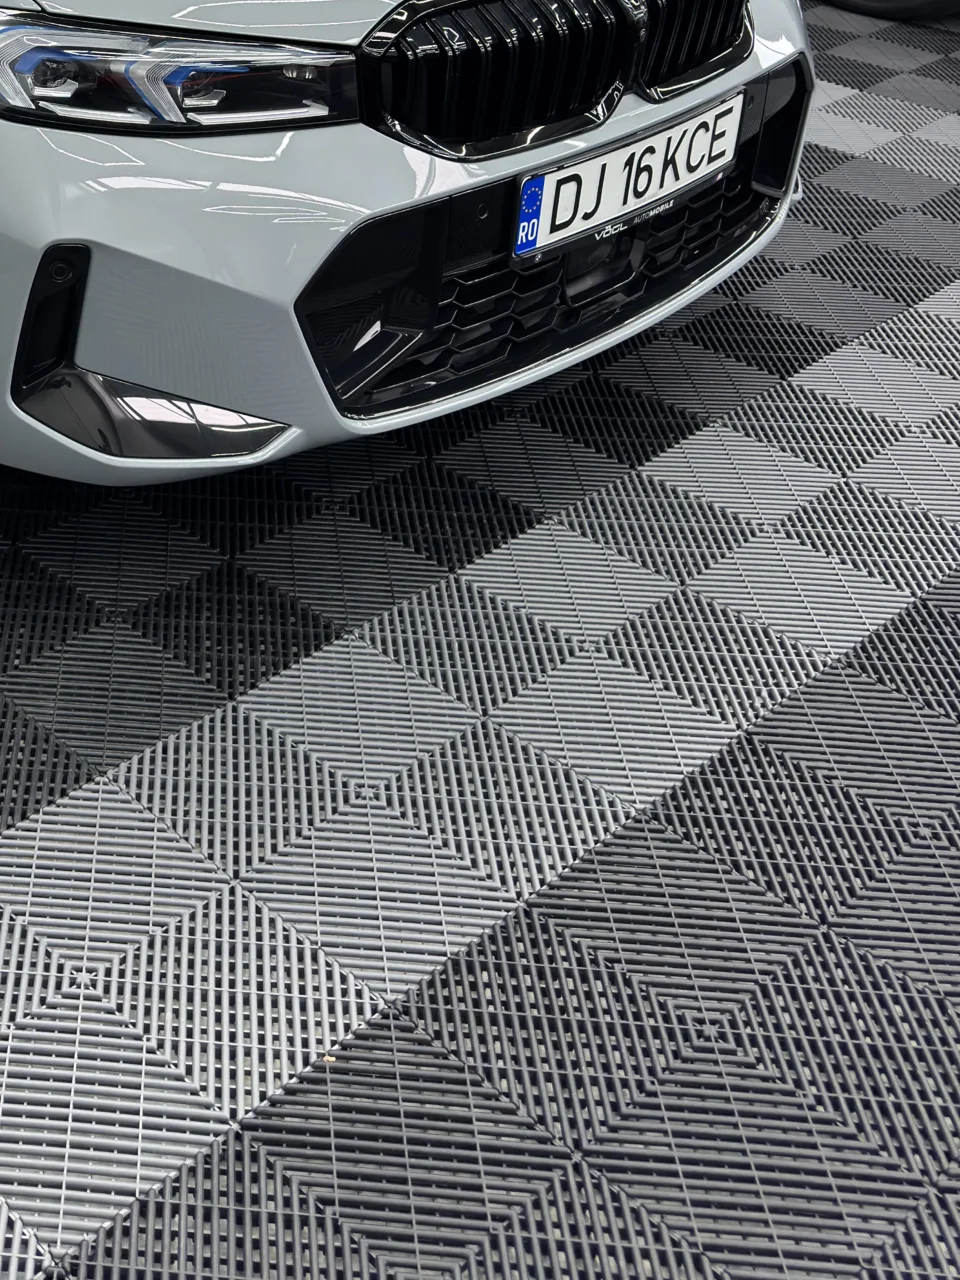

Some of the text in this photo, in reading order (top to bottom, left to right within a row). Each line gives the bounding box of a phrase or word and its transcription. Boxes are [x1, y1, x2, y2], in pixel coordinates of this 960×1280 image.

[549, 106, 734, 234] DJ 16 KCE
[517, 218, 538, 245] RO
